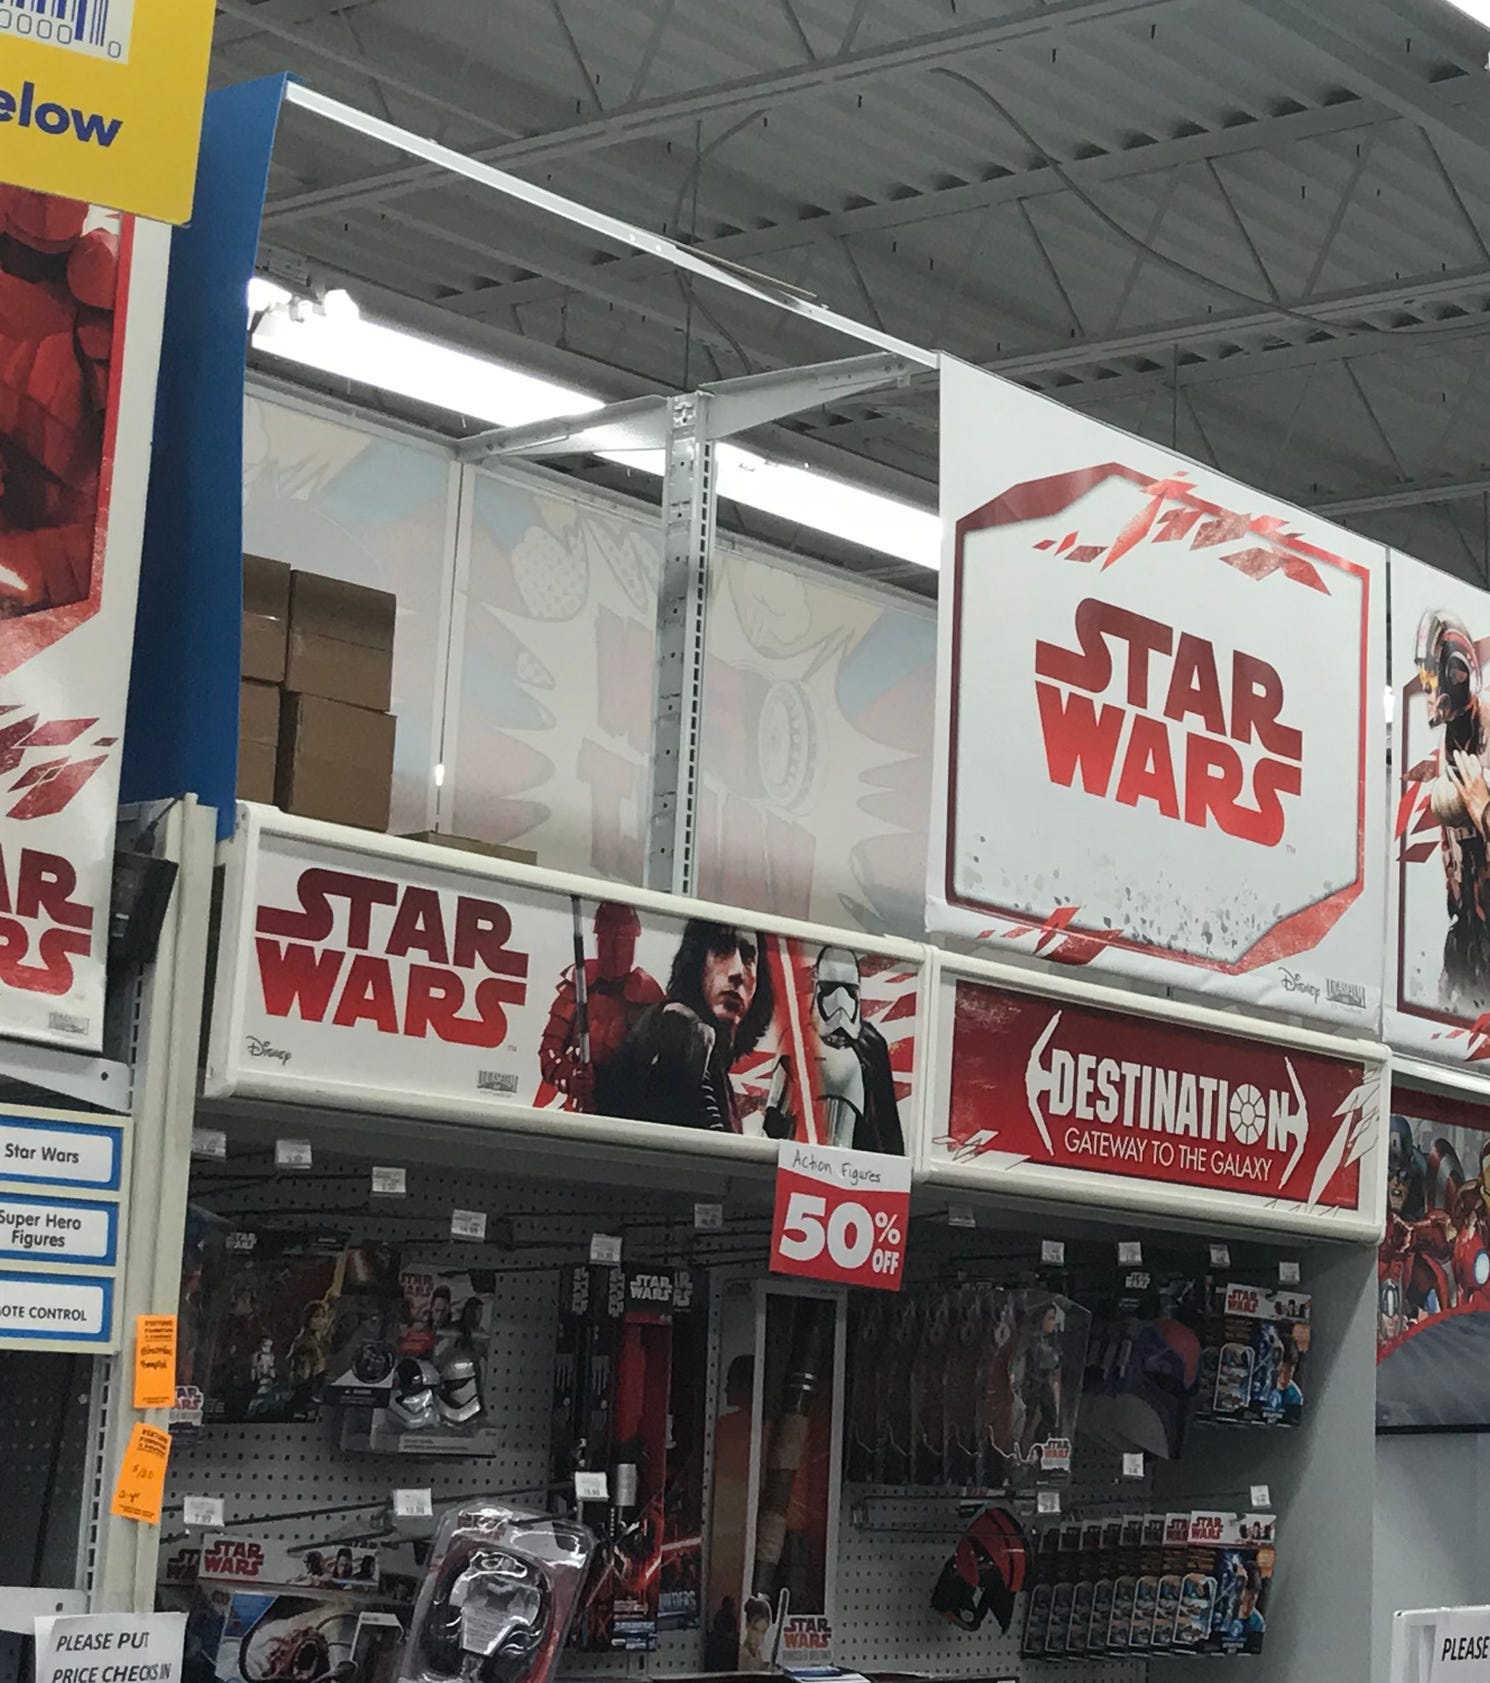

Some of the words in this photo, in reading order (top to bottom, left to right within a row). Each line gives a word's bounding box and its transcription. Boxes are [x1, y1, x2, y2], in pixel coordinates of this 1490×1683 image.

[1035, 597, 1303, 762] STAR
[1034, 680, 1303, 848] WARS
[256, 867, 530, 978] STAR
[254, 936, 528, 1049] WARS
[1048, 1048, 1291, 1153] DESTINATION
[5, 1142, 36, 1159] Star
[41, 1146, 80, 1164] Wars
[1064, 1127, 1147, 1162] GATEWAY
[1151, 1140, 1175, 1167] TO
[1178, 1144, 1206, 1172] THE
[1210, 1150, 1273, 1181] GALAXY
[792, 1148, 833, 1175] Action
[841, 1162, 881, 1186] Figures
[0, 1208, 41, 1229] Super
[46, 1212, 82, 1231] Hero
[11, 1228, 65, 1249] Figures
[872, 1248, 900, 1275] OFF
[630, 1273, 673, 1288] STAR
[630, 1286, 673, 1301] WARS
[29, 1306, 87, 1321] CONTROL
[205, 1539, 264, 1560] STAR
[204, 1554, 264, 1577] WARS
[783, 1617, 832, 1633] STAR
[56, 1632, 114, 1652] PLEASE
[117, 1631, 150, 1649] PUT
[783, 1632, 832, 1649] WARS
[1441, 1635, 1490, 1662] PLEASE
[52, 1666, 98, 1683] PRICE
